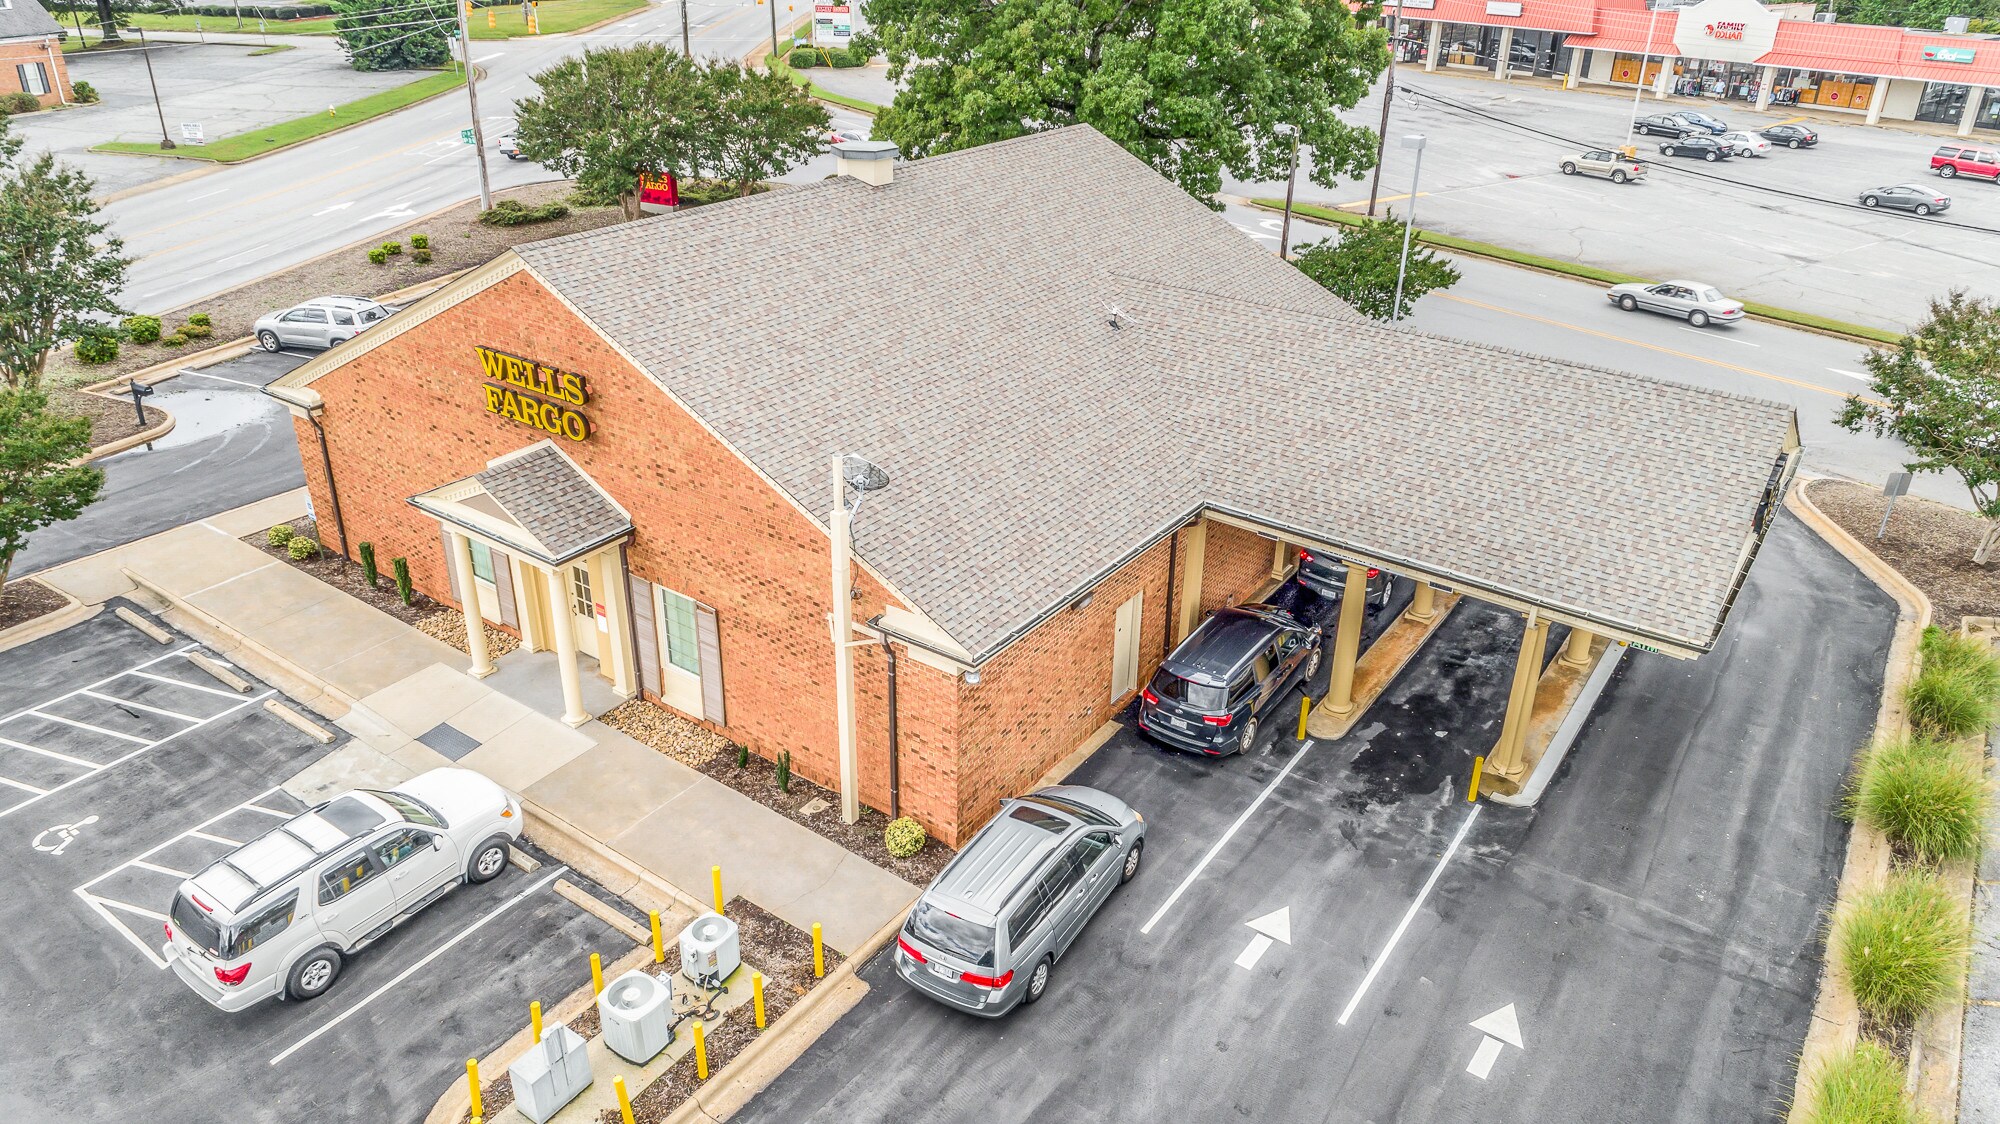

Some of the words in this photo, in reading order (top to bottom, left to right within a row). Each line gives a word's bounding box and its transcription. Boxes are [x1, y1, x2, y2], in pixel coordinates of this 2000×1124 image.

[1717, 21, 1746, 31] FAMILY
[474, 345, 588, 406] WELLS
[482, 382, 590, 442] FARGO
